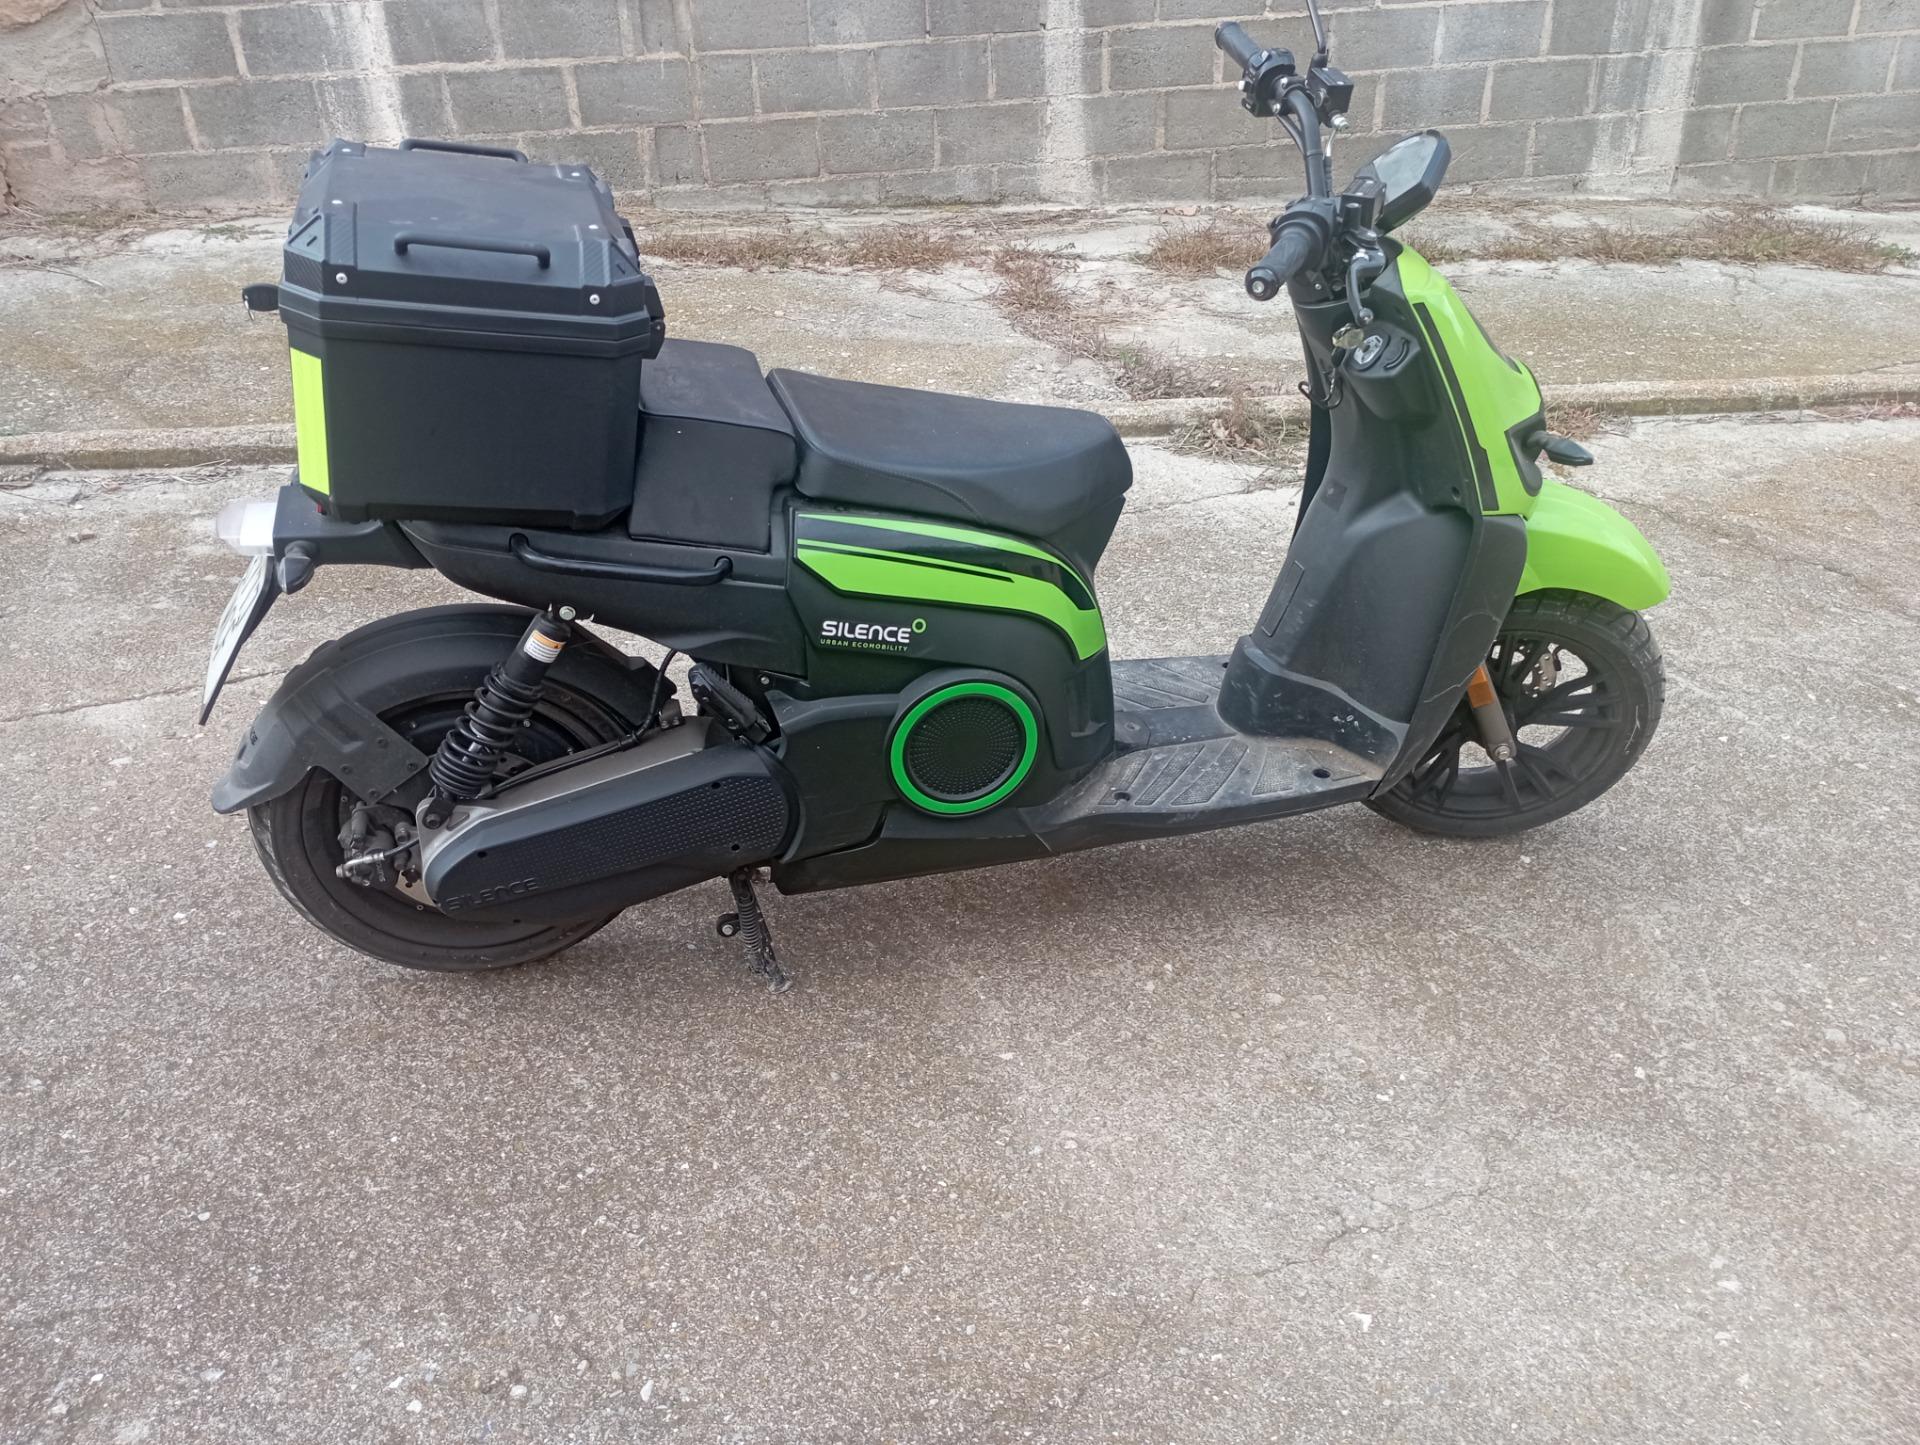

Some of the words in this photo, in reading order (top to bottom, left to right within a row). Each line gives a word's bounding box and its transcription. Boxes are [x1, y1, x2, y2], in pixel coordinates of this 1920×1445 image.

[821, 620, 911, 643] SILENCE
[820, 638, 849, 647] URBAN
[851, 641, 908, 652] ECOMOBILITY
[446, 876, 540, 911] SILENCE
